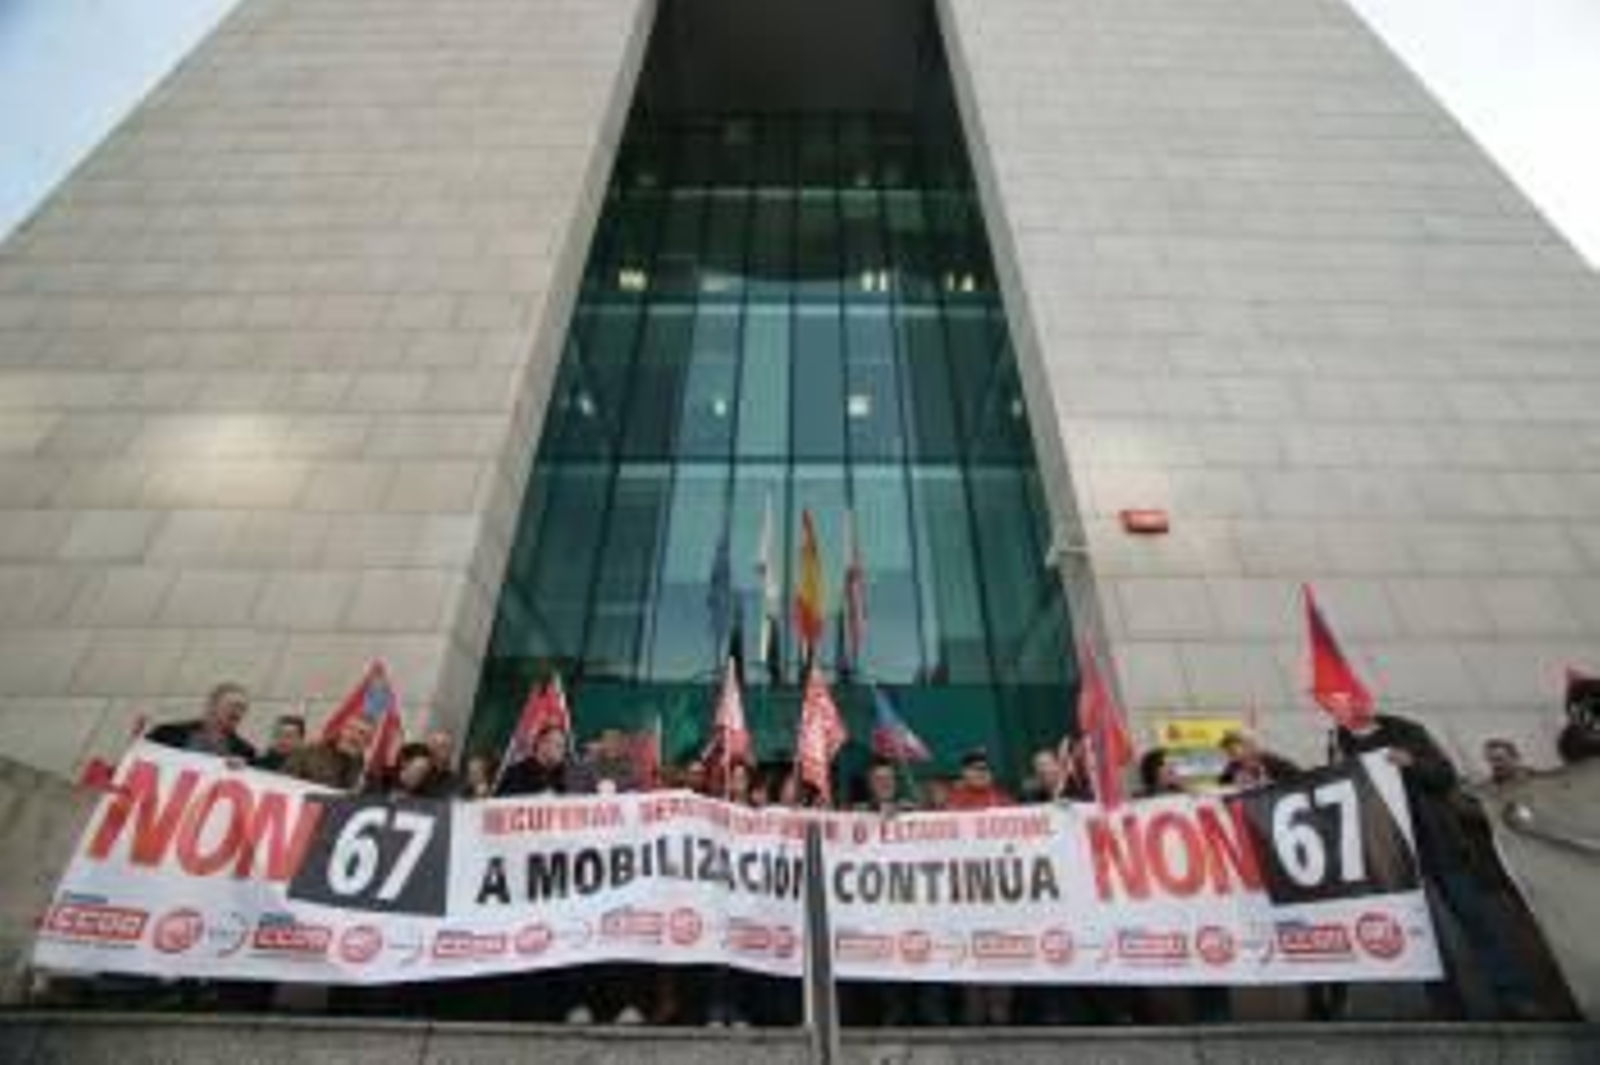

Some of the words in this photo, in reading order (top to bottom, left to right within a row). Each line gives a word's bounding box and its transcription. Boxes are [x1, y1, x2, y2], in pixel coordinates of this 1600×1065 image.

[88, 761, 325, 884] NON
[327, 805, 437, 899] 67
[477, 857, 511, 904] A
[833, 843, 1059, 902] CONTINÚA
[1086, 799, 1267, 901] NON
[1273, 779, 1368, 887] 67
